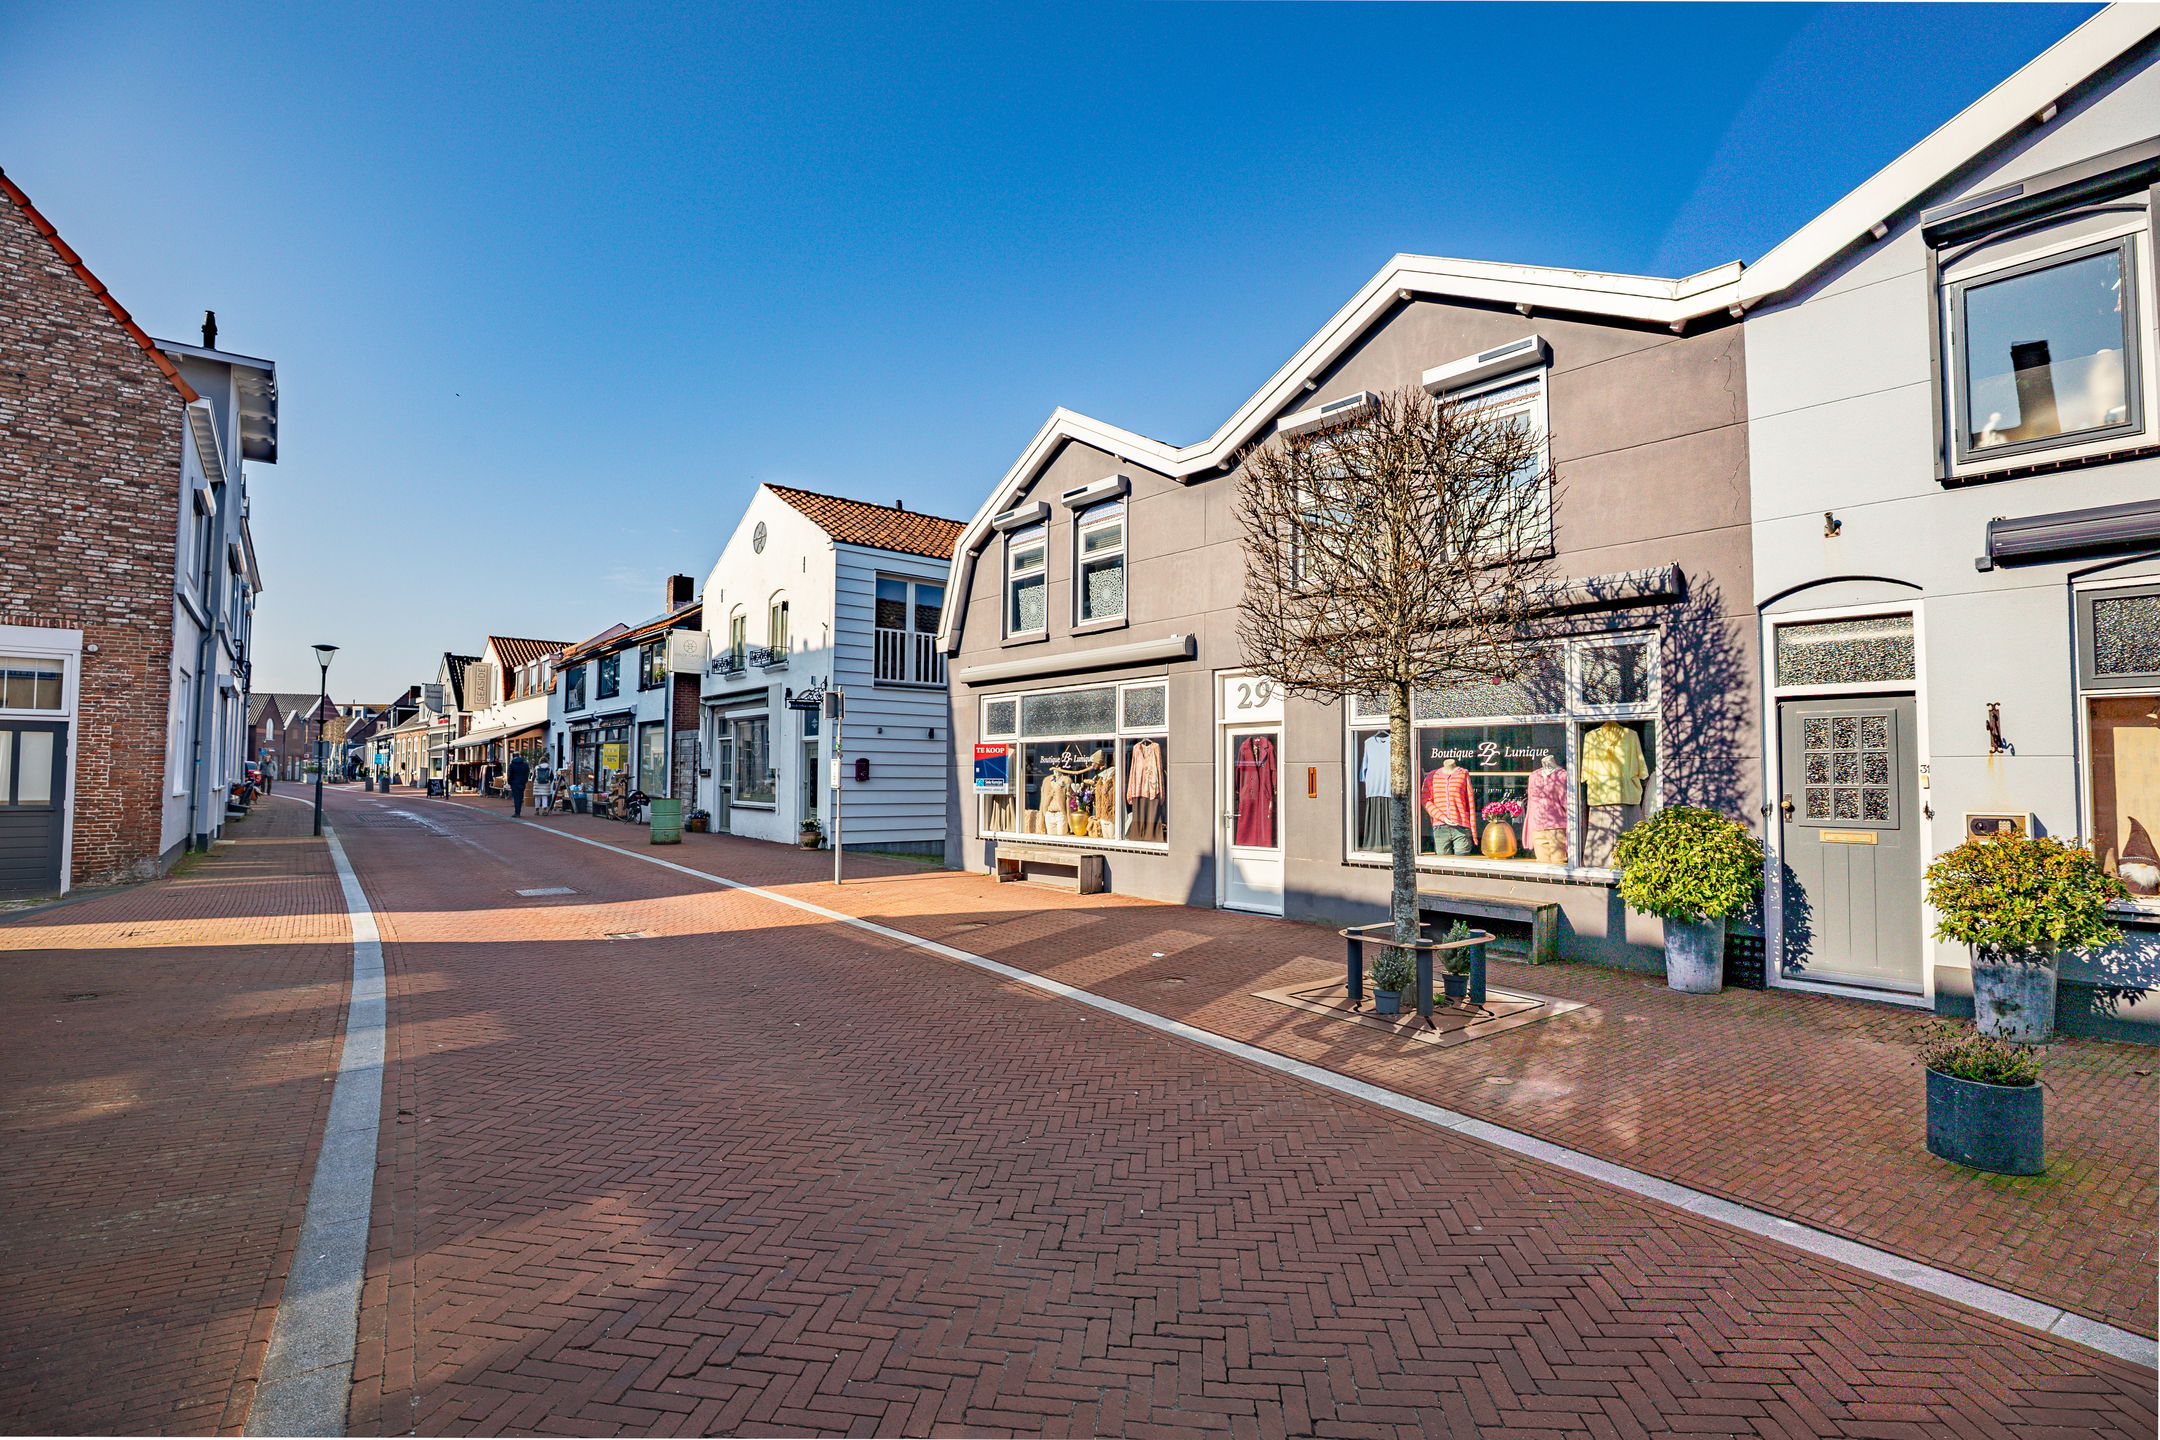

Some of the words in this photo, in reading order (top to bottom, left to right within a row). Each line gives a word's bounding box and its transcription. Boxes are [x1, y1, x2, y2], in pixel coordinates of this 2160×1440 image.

[477, 666, 486, 702] SEASIDE
[1237, 682, 1271, 709] 29
[1040, 756, 1060, 765] Boutique
[1431, 748, 1474, 761] Boutique
[1504, 746, 1549, 760] Lunique
[1920, 764, 1930, 773] 31
